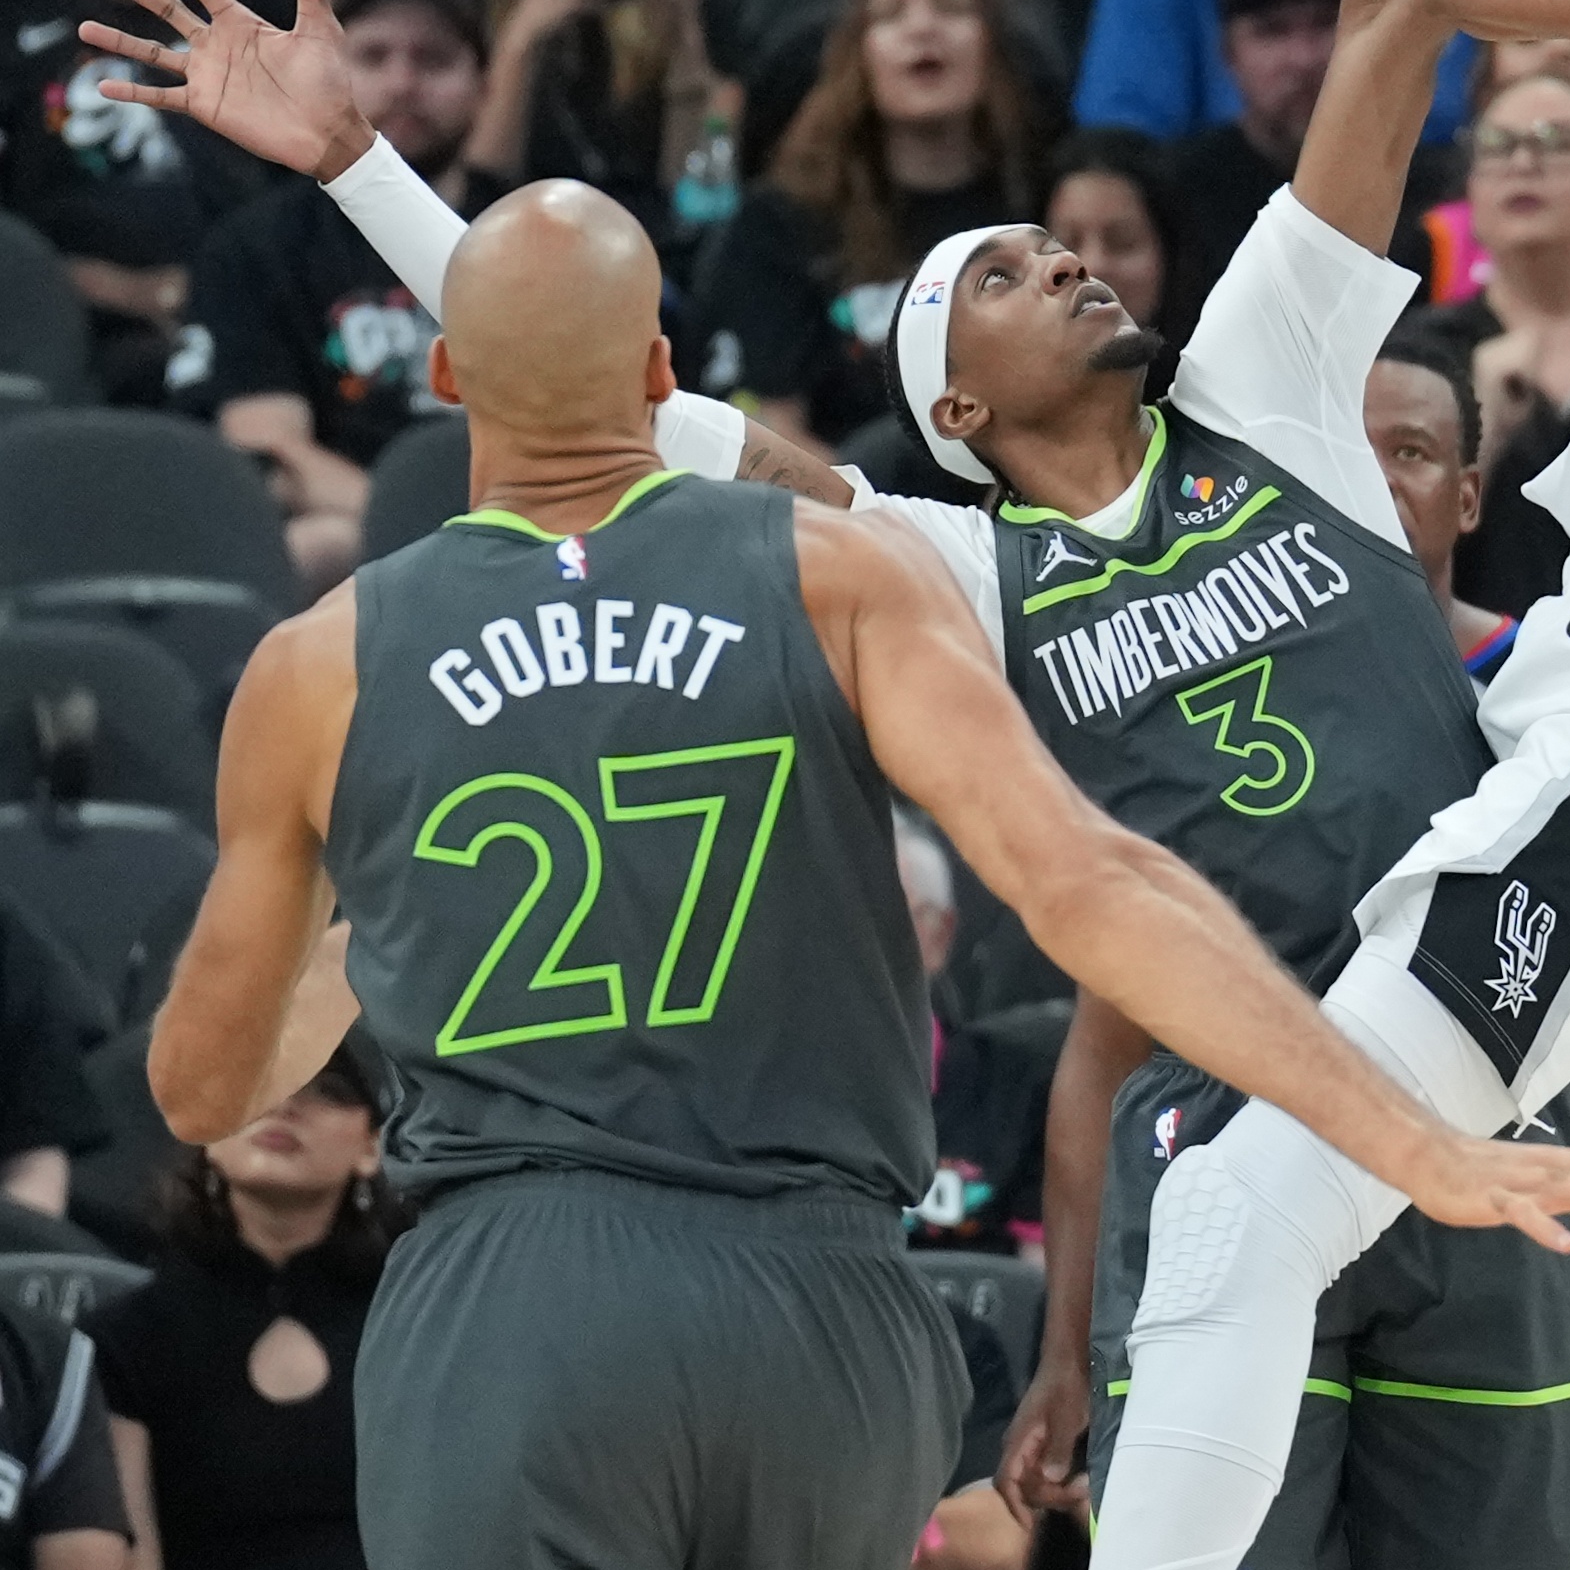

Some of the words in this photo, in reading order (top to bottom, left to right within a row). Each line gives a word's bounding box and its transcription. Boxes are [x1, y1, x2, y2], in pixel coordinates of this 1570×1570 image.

[1174, 474, 1250, 526] sezzle
[429, 598, 746, 727] GOBERT
[1033, 522, 1350, 726] TIMBERWOLVES
[1175, 654, 1315, 817] 3
[413, 735, 796, 1058] 27
